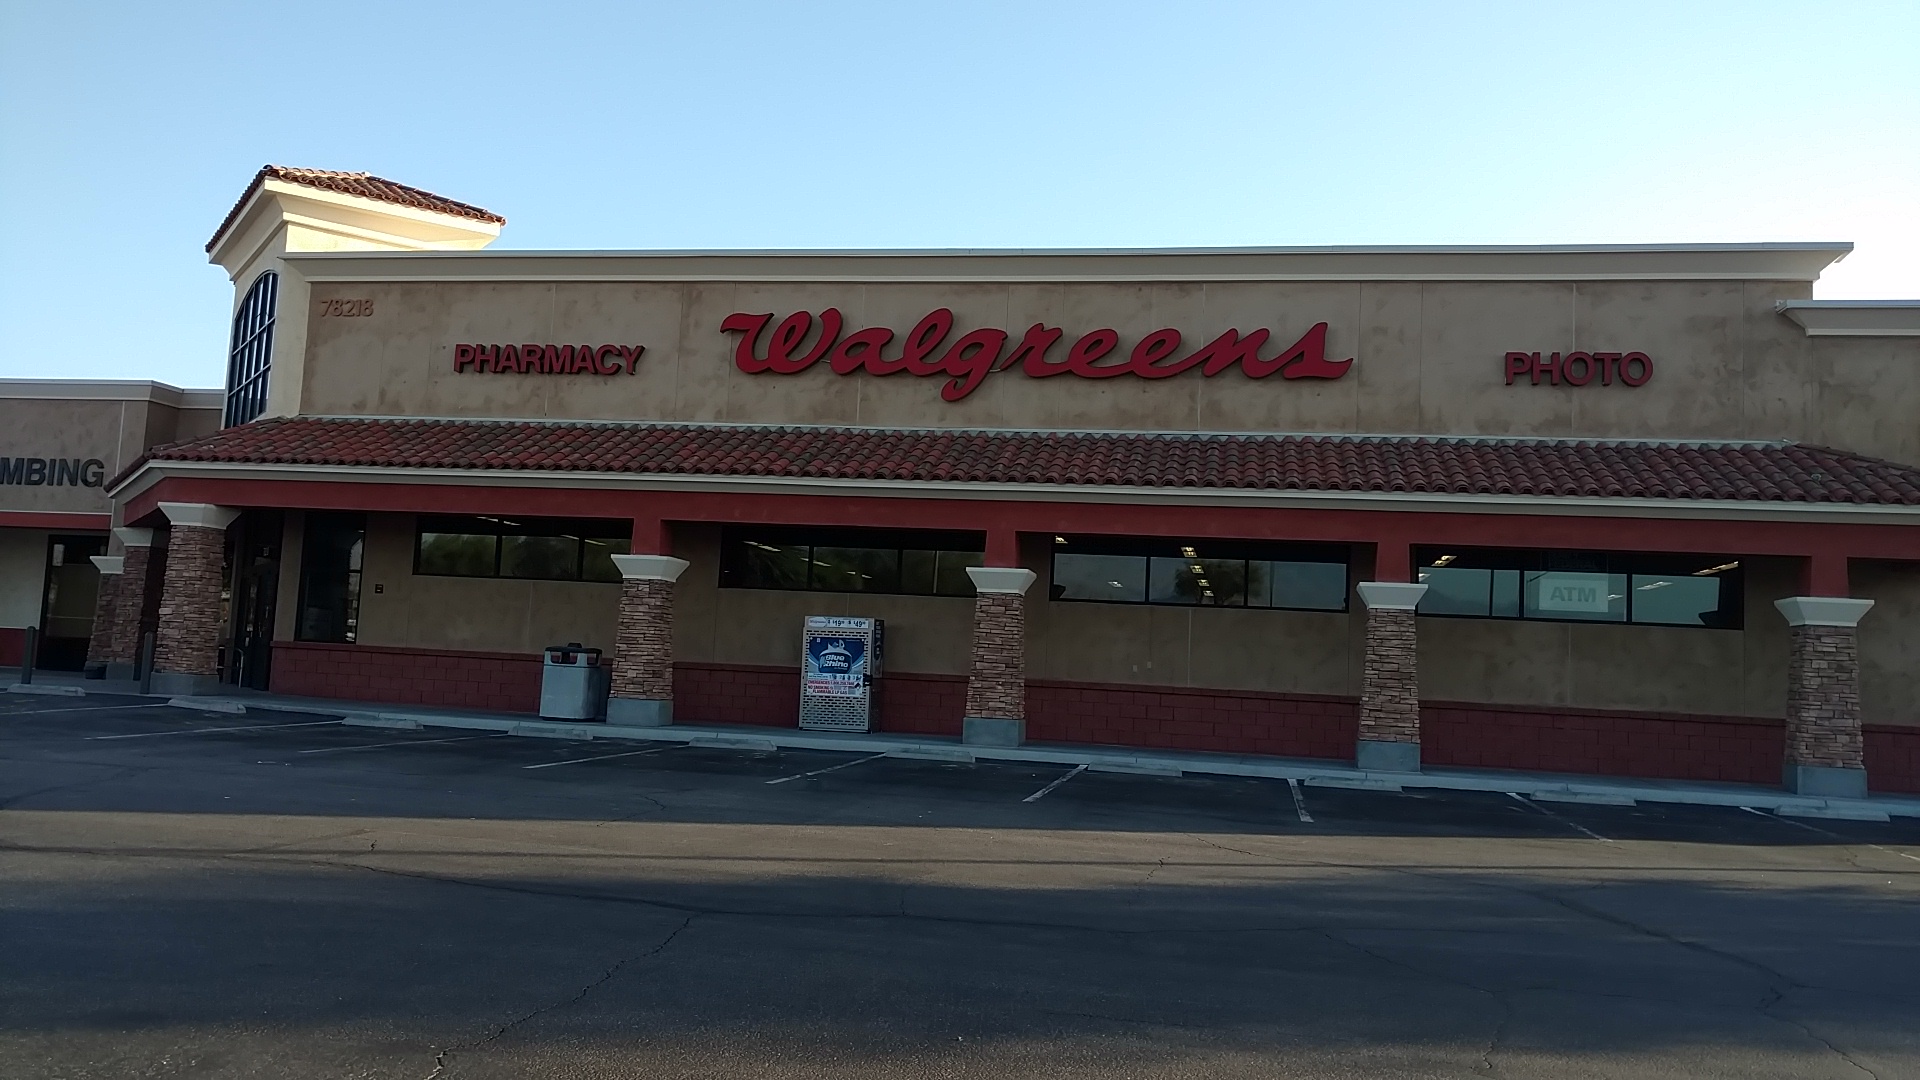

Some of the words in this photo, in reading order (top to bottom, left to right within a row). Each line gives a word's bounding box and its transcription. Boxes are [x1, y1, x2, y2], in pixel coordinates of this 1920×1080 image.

[320, 298, 374, 317] 78218
[453, 343, 646, 375] PHARMACY
[720, 307, 1354, 401] Walgreens
[1505, 351, 1653, 387] PHOTO
[1550, 586, 1597, 602] ATM
